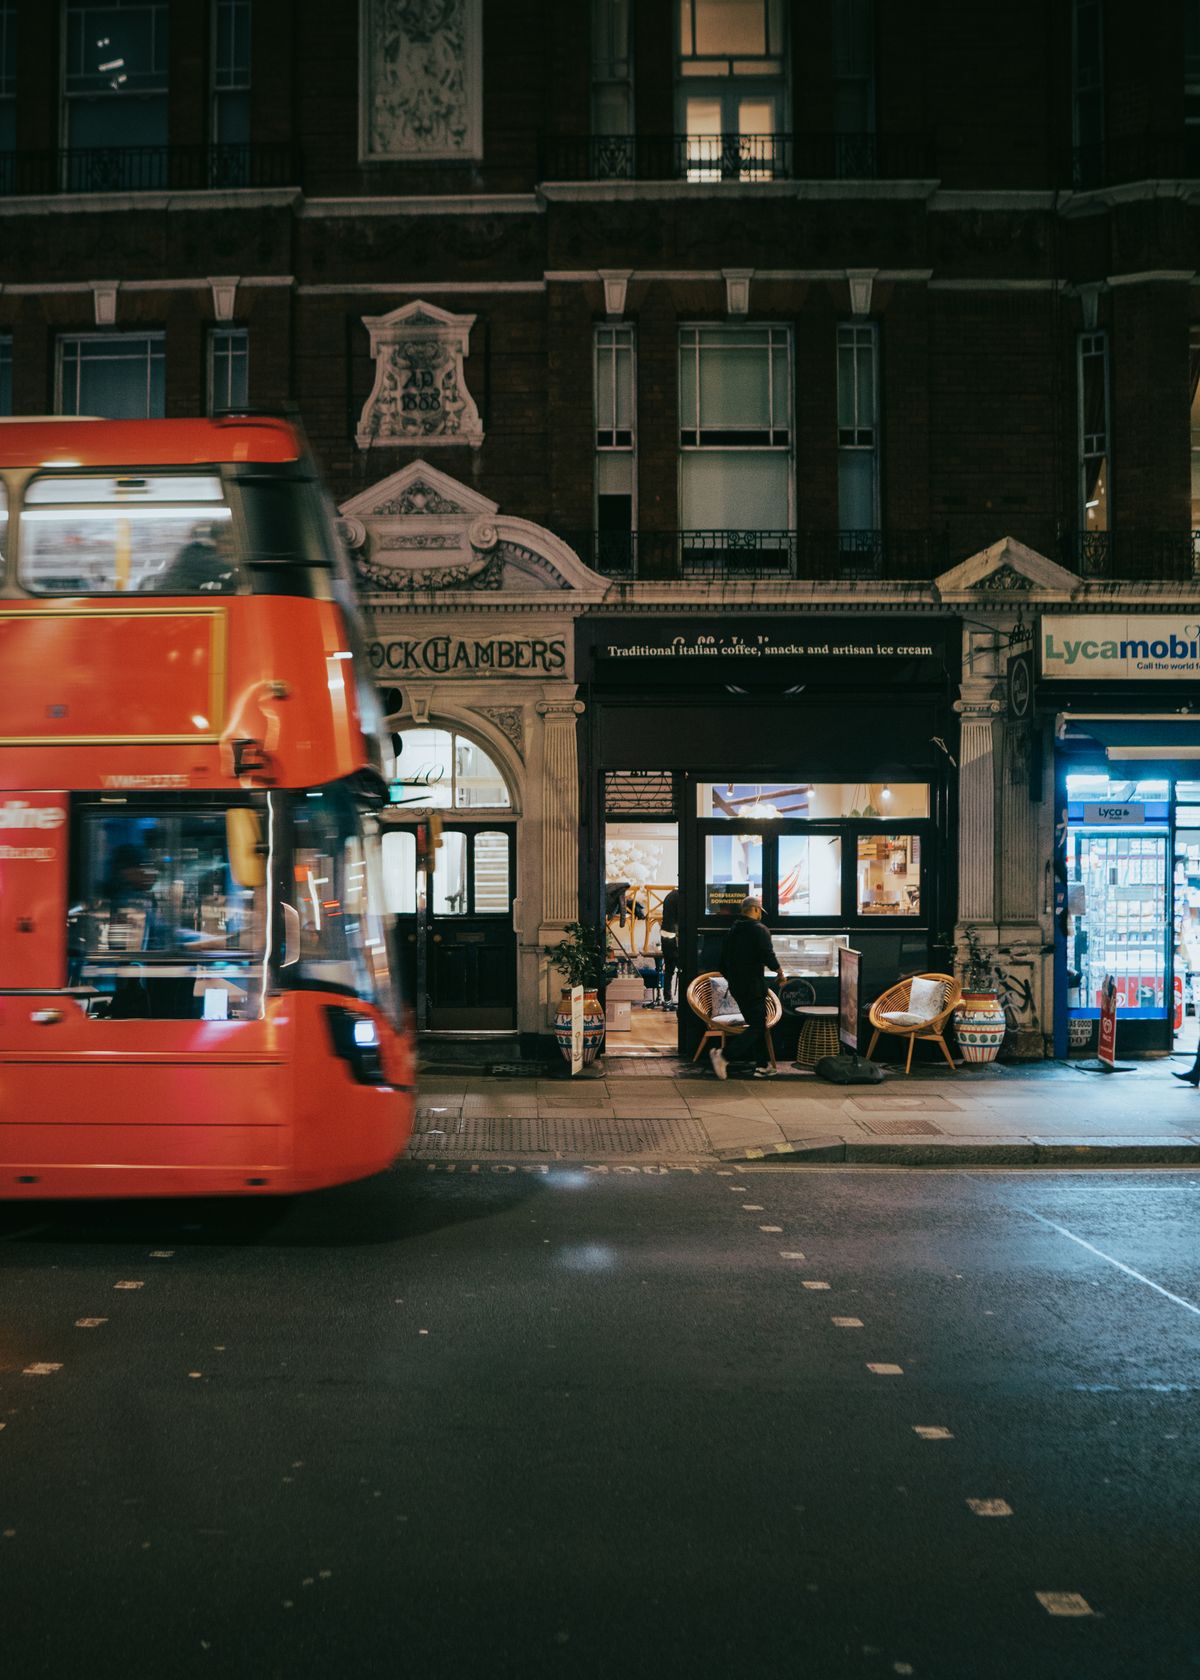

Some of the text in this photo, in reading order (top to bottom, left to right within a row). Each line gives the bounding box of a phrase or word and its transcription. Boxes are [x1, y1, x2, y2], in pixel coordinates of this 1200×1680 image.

[368, 636, 566, 673] OCK CHAMBERS
[607, 645, 676, 657] Traditional
[721, 644, 761, 657] coffee,
[764, 644, 805, 655] snacks
[807, 643, 829, 655] and
[832, 643, 874, 655] artisan
[877, 643, 894, 655] ice
[896, 645, 933, 656] cream
[1137, 662, 1154, 670] Call
[1155, 662, 1169, 670] the
[1170, 662, 1194, 670] world
[1098, 807, 1122, 818] Lyca
